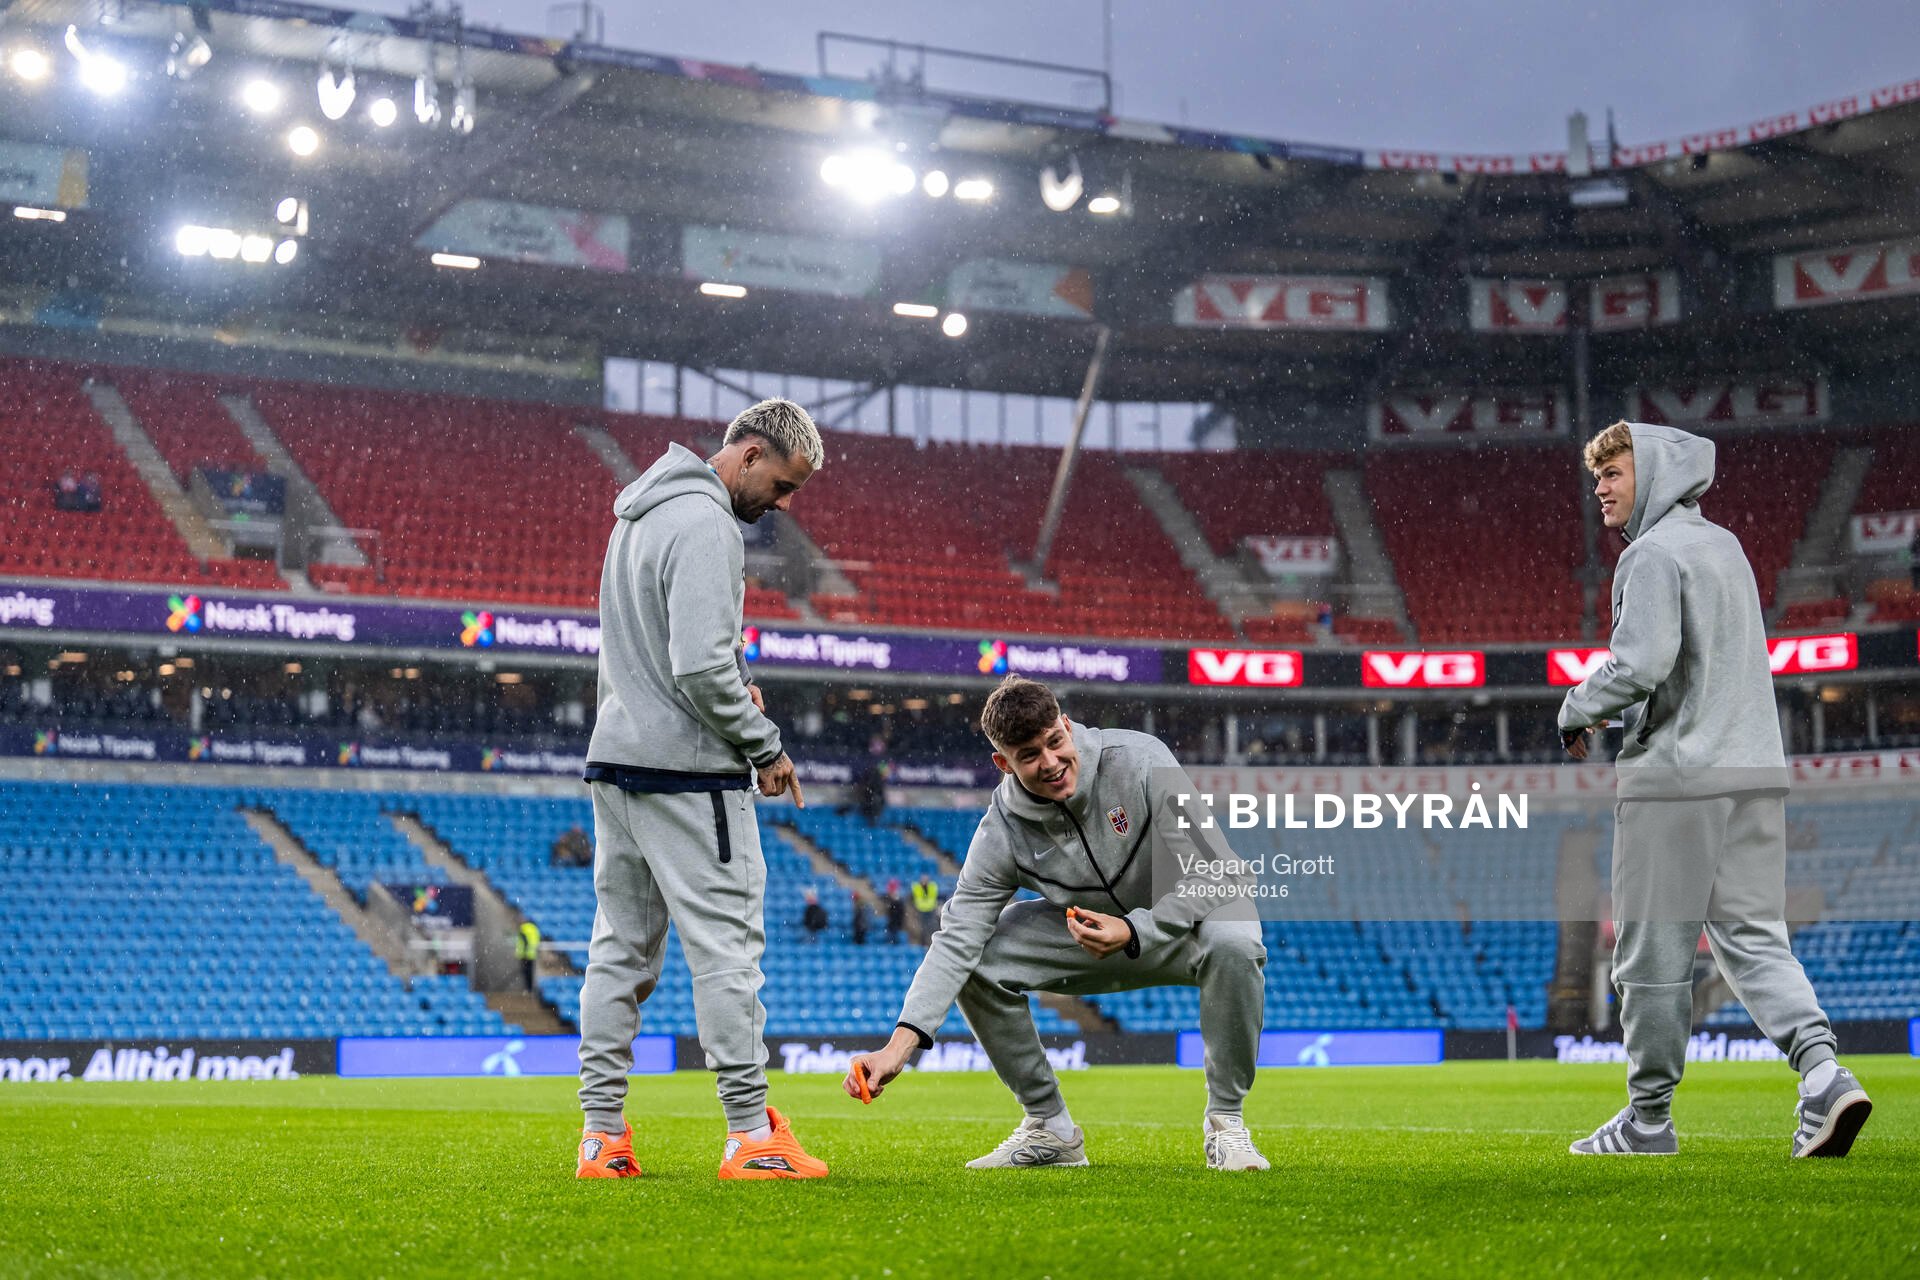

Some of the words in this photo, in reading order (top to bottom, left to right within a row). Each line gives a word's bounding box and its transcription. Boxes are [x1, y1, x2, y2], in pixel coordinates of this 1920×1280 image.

[1194, 280, 1367, 323] VG
[1381, 394, 1555, 434] VG
[1638, 380, 1818, 422] VG
[204, 600, 272, 632] Norsk
[271, 604, 356, 642] Tipping
[495, 616, 558, 647] Norsk
[557, 619, 600, 653] Tipp
[759, 631, 818, 660] Norsk
[817, 634, 891, 669] Tipping
[1006, 645, 1063, 672] Norsk
[1060, 647, 1129, 681] Tipping
[1194, 651, 1295, 684] VG
[1552, 651, 1613, 682] V
[1368, 653, 1477, 685] VG
[83, 1046, 195, 1082] Alltid
[197, 1047, 299, 1081] med.
[1045, 1040, 1090, 1071] ed.
[1553, 1035, 1628, 1064] Telen
